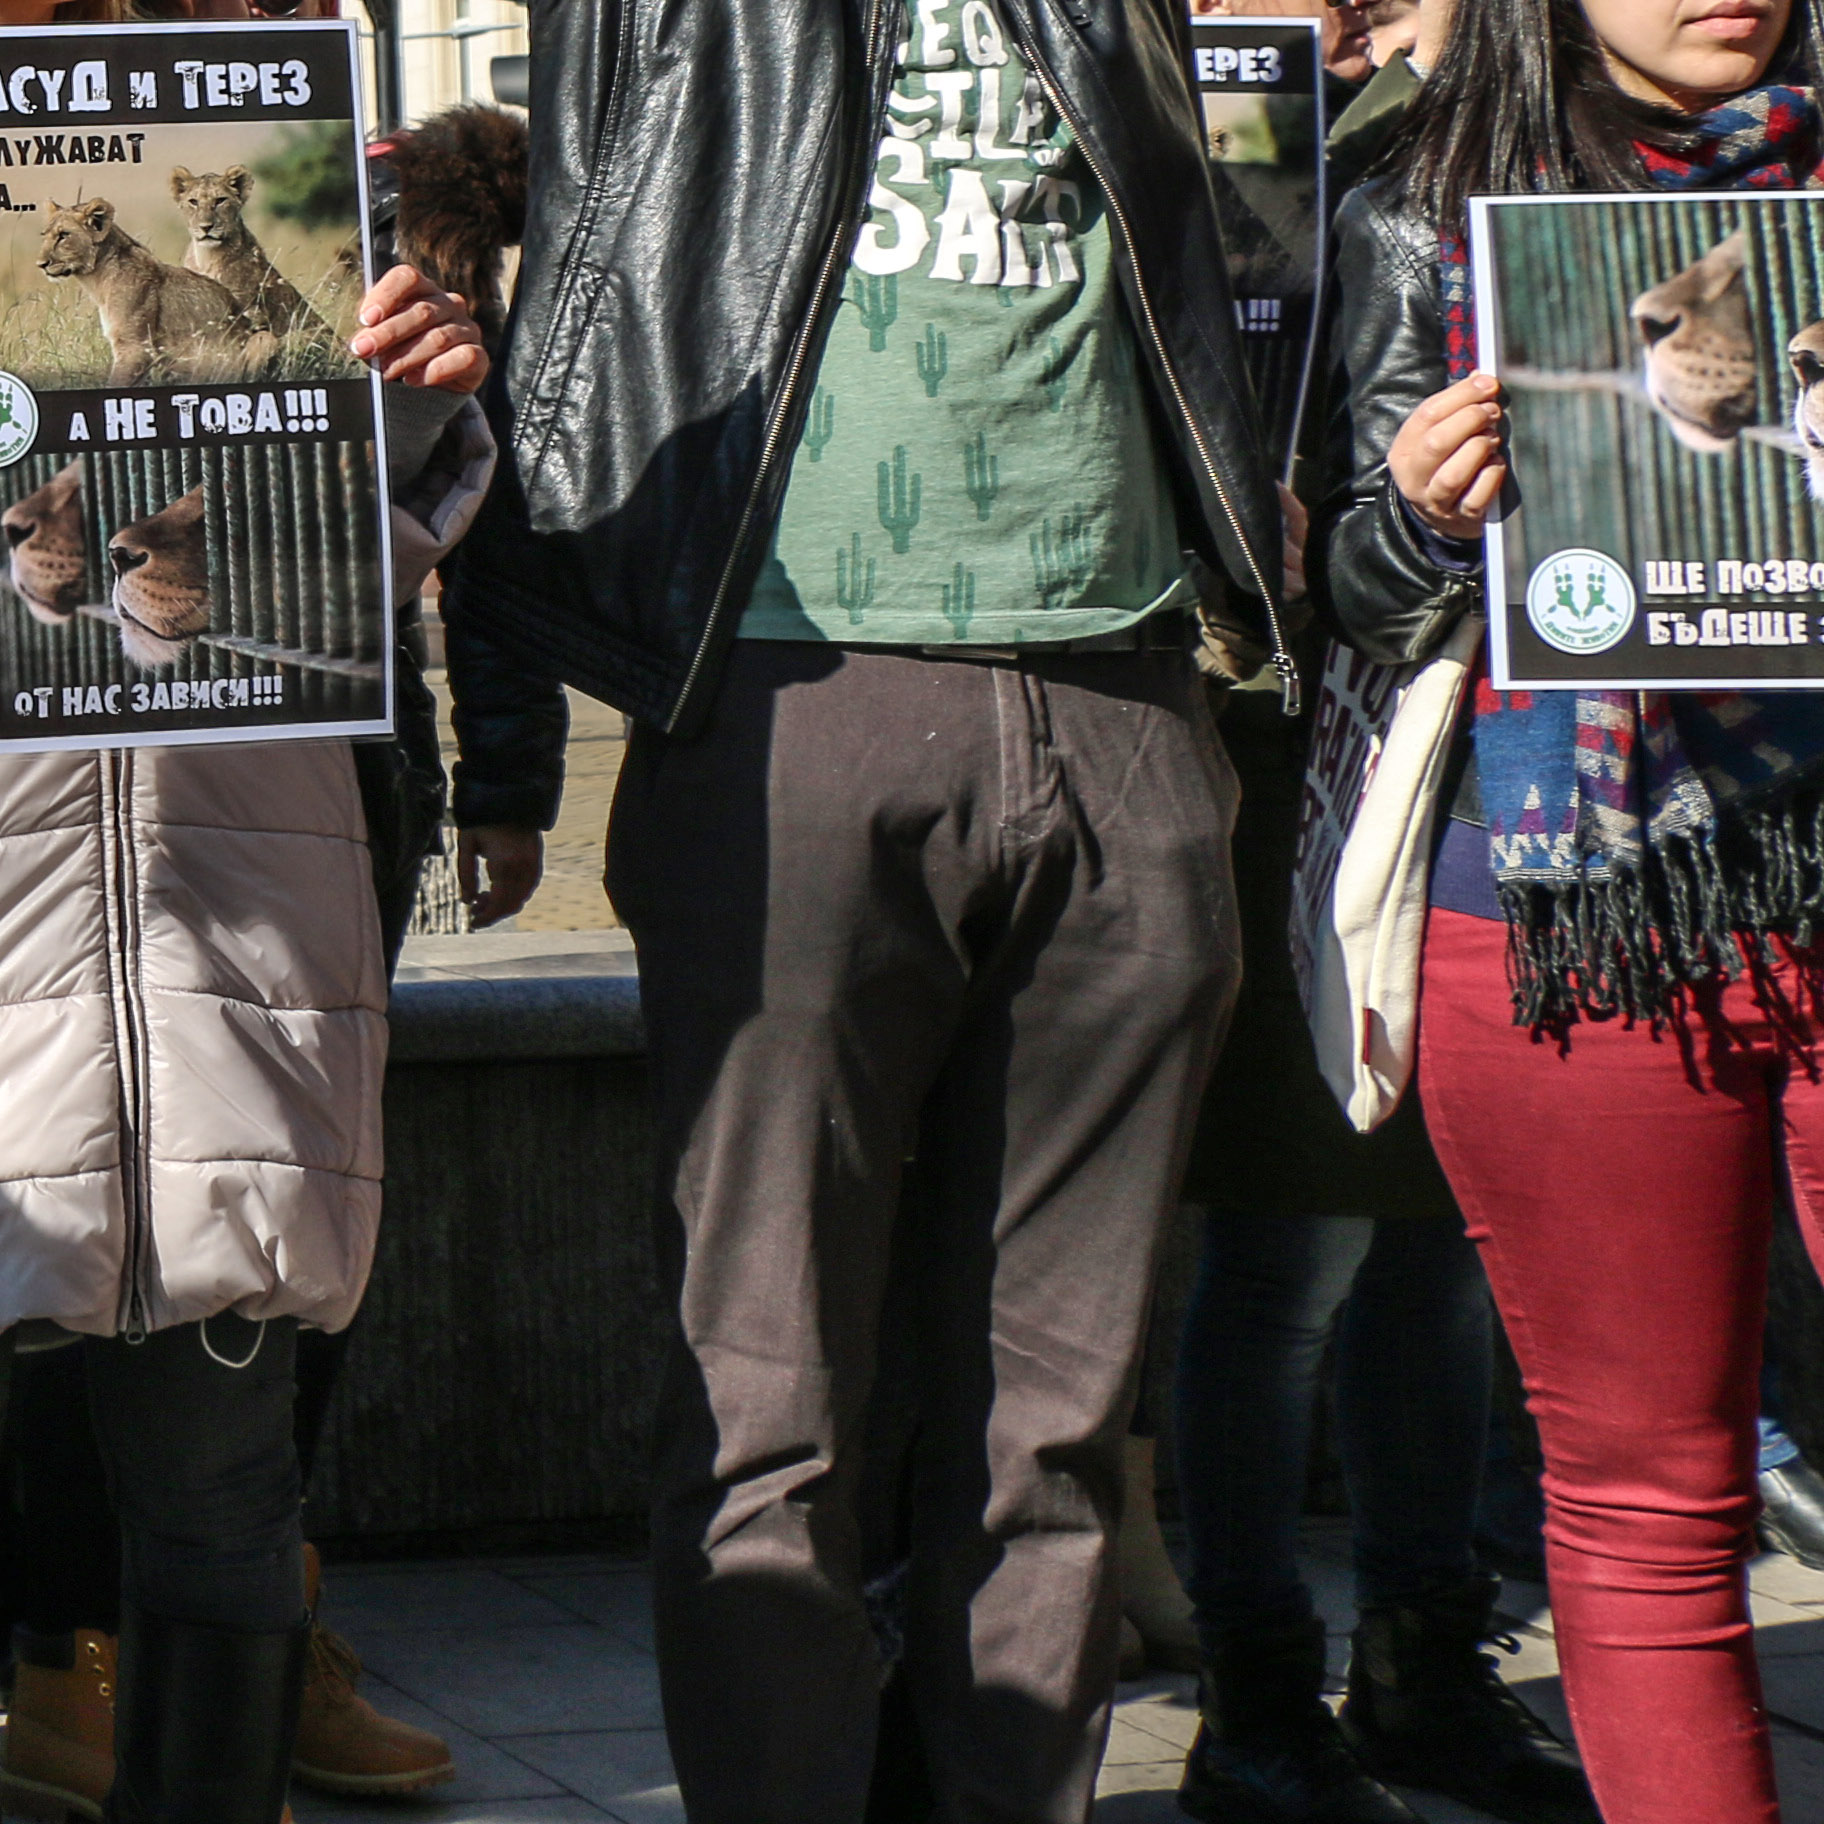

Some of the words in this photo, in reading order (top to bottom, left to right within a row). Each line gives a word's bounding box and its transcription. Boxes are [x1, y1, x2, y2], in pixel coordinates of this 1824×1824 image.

[1194, 45, 1283, 83] ЕРЕЗ
[174, 59, 313, 111] ТЕРЕЗ
[104, 397, 157, 441] НЕ
[170, 388, 331, 439] ТОВА!!!
[1645, 560, 1706, 595] ЩЕ
[1647, 607, 1809, 647] БЪДЕЩЕ
[62, 682, 123, 717] НАС
[131, 675, 284, 714] ЗАВИСИ!!!
